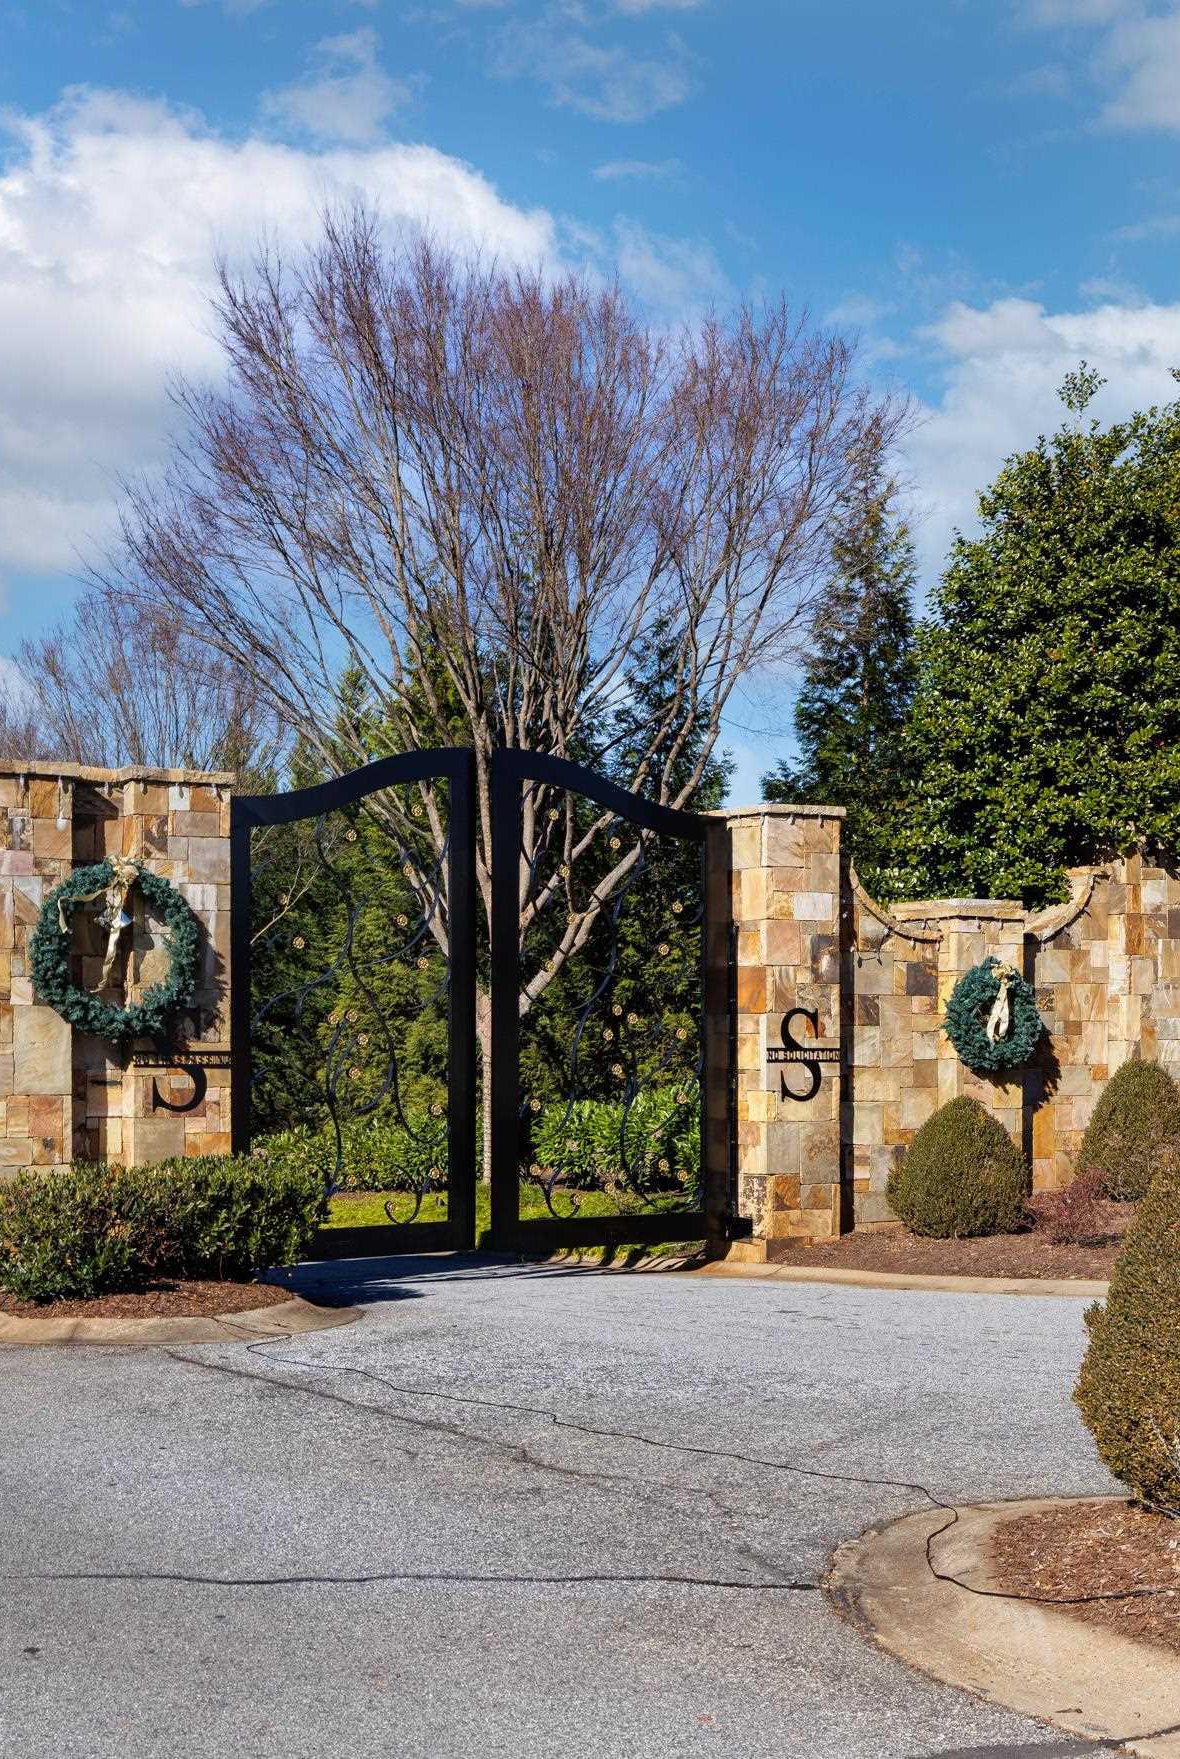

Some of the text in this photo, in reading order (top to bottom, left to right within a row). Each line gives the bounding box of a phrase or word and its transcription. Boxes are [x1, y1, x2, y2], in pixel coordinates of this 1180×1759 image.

[767, 1050, 840, 1060] NO SOLICITATION
[781, 1007, 821, 1102] S
